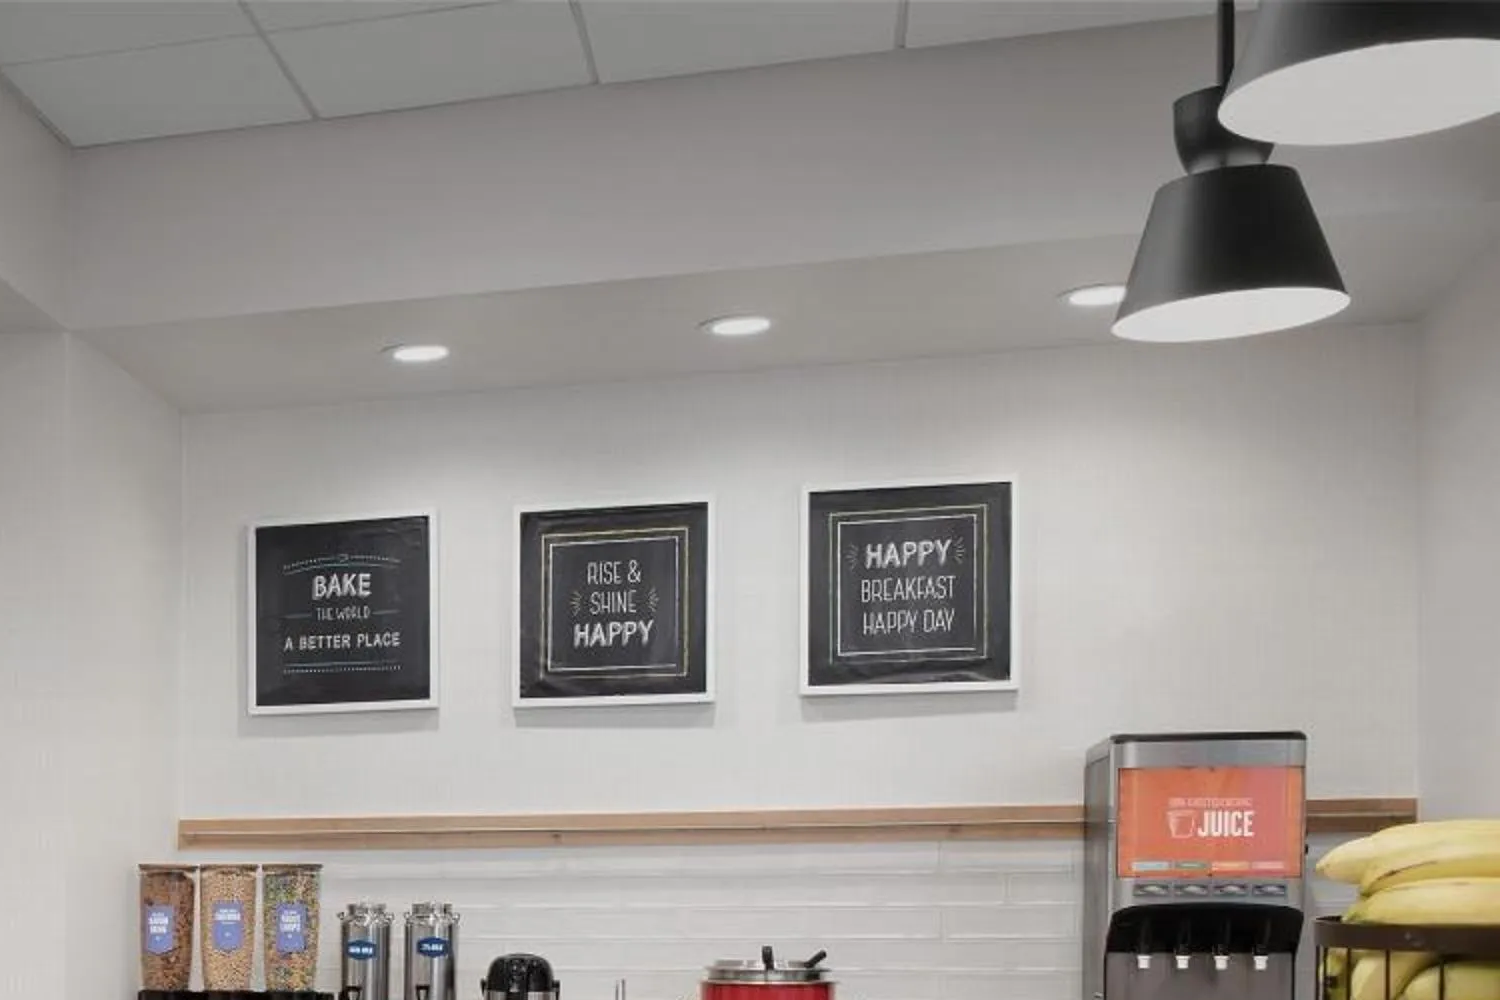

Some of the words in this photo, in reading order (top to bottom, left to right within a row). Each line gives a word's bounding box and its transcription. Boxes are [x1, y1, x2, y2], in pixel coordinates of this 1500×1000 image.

[865, 539, 952, 569] HAPPY
[587, 561, 623, 585] RISE
[627, 559, 642, 583] &
[312, 573, 373, 600] BAKE
[861, 575, 956, 603] BREAKFAST
[316, 606, 334, 621] THE
[335, 605, 371, 620] WORLD
[589, 589, 638, 615] SHINE
[573, 620, 654, 648] HAPPY
[863, 610, 918, 635] HAPPY
[923, 608, 955, 633] DAY
[284, 637, 293, 651] A
[299, 635, 350, 650] BETTER
[357, 632, 401, 648] PLACE
[1198, 810, 1255, 837] JUICE
